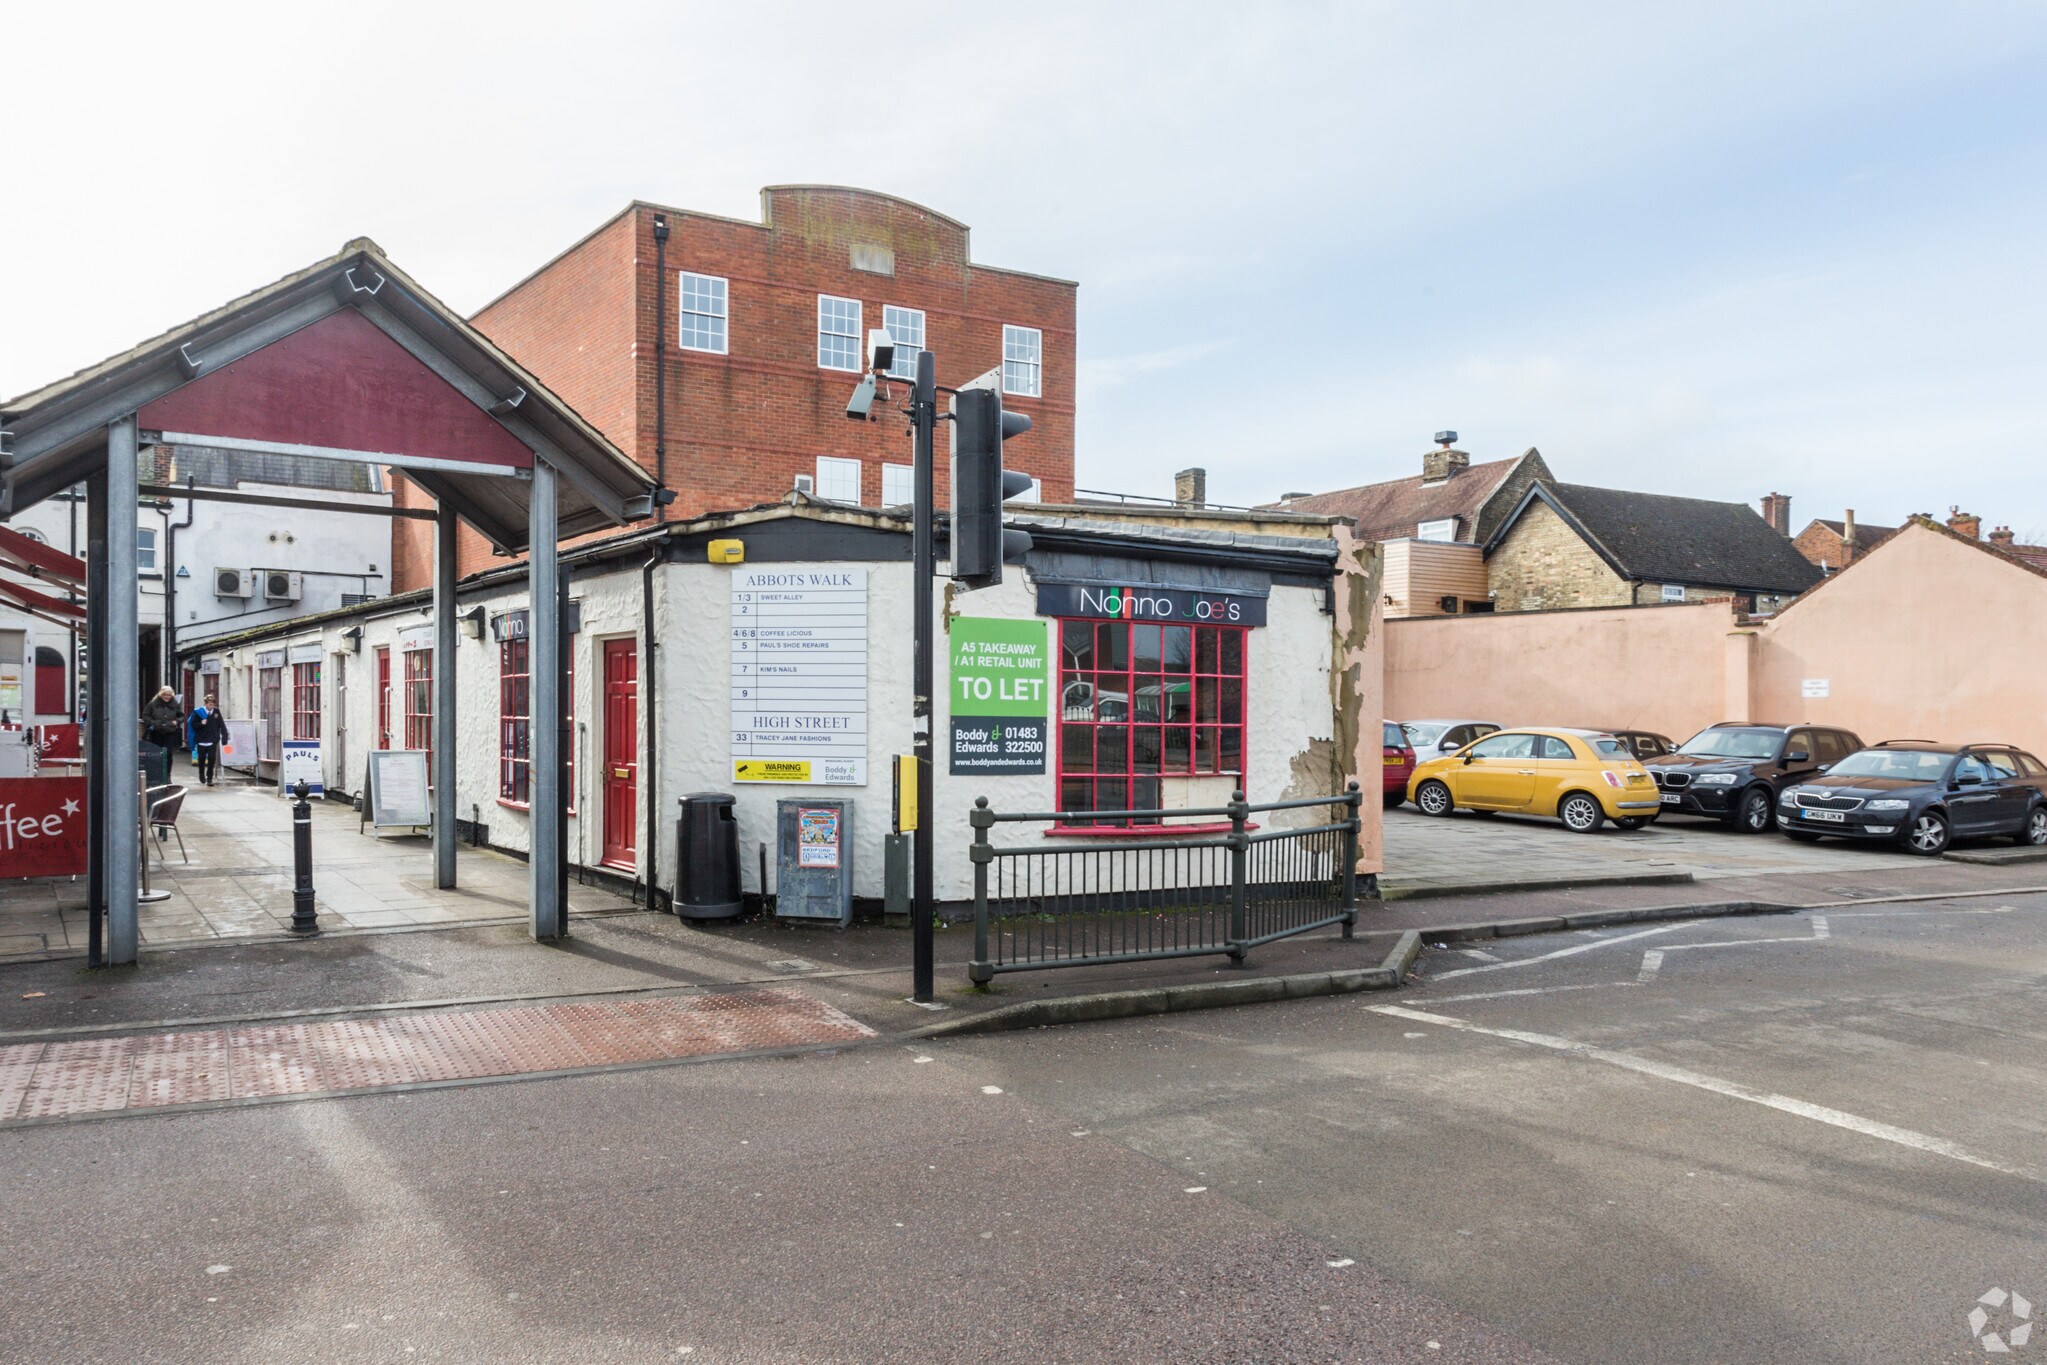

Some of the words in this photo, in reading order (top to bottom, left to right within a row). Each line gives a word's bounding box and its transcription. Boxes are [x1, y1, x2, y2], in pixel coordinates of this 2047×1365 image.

[746, 574, 805, 586] ABBOTS
[809, 574, 852, 586] WALK
[737, 593, 751, 602] 1/3
[742, 606, 748, 614] 2
[1080, 588, 1173, 616] Nonno
[1182, 594, 1240, 621] Joe's
[733, 629, 756, 638] 4/6/8
[742, 641, 748, 649] 5
[961, 642, 976, 653] A5
[978, 642, 1037, 655] TAKEAWAY
[960, 656, 975, 666] A1
[977, 656, 1015, 668] RETAIL
[1018, 657, 1042, 669] UNIT
[742, 665, 748, 673] 7
[742, 689, 748, 698] 9
[958, 676, 992, 700] TO
[1000, 677, 1044, 701] LET
[753, 716, 790, 729] HIGH
[795, 716, 851, 729] STREET
[736, 733, 747, 742] 33
[755, 734, 780, 742] TRACEY
[781, 734, 798, 742] JANE
[799, 734, 832, 742] FASHIONS
[955, 728, 988, 743] Boddy
[1005, 727, 1038, 739] 01483
[955, 741, 999, 753] Edwards
[1005, 741, 1043, 753] 322500
[285, 750, 320, 762] PAULS
[764, 763, 802, 771] WARNING
[954, 758, 1043, 768] www.boddyandedwards.co.uk
[825, 766, 848, 775] Boddy
